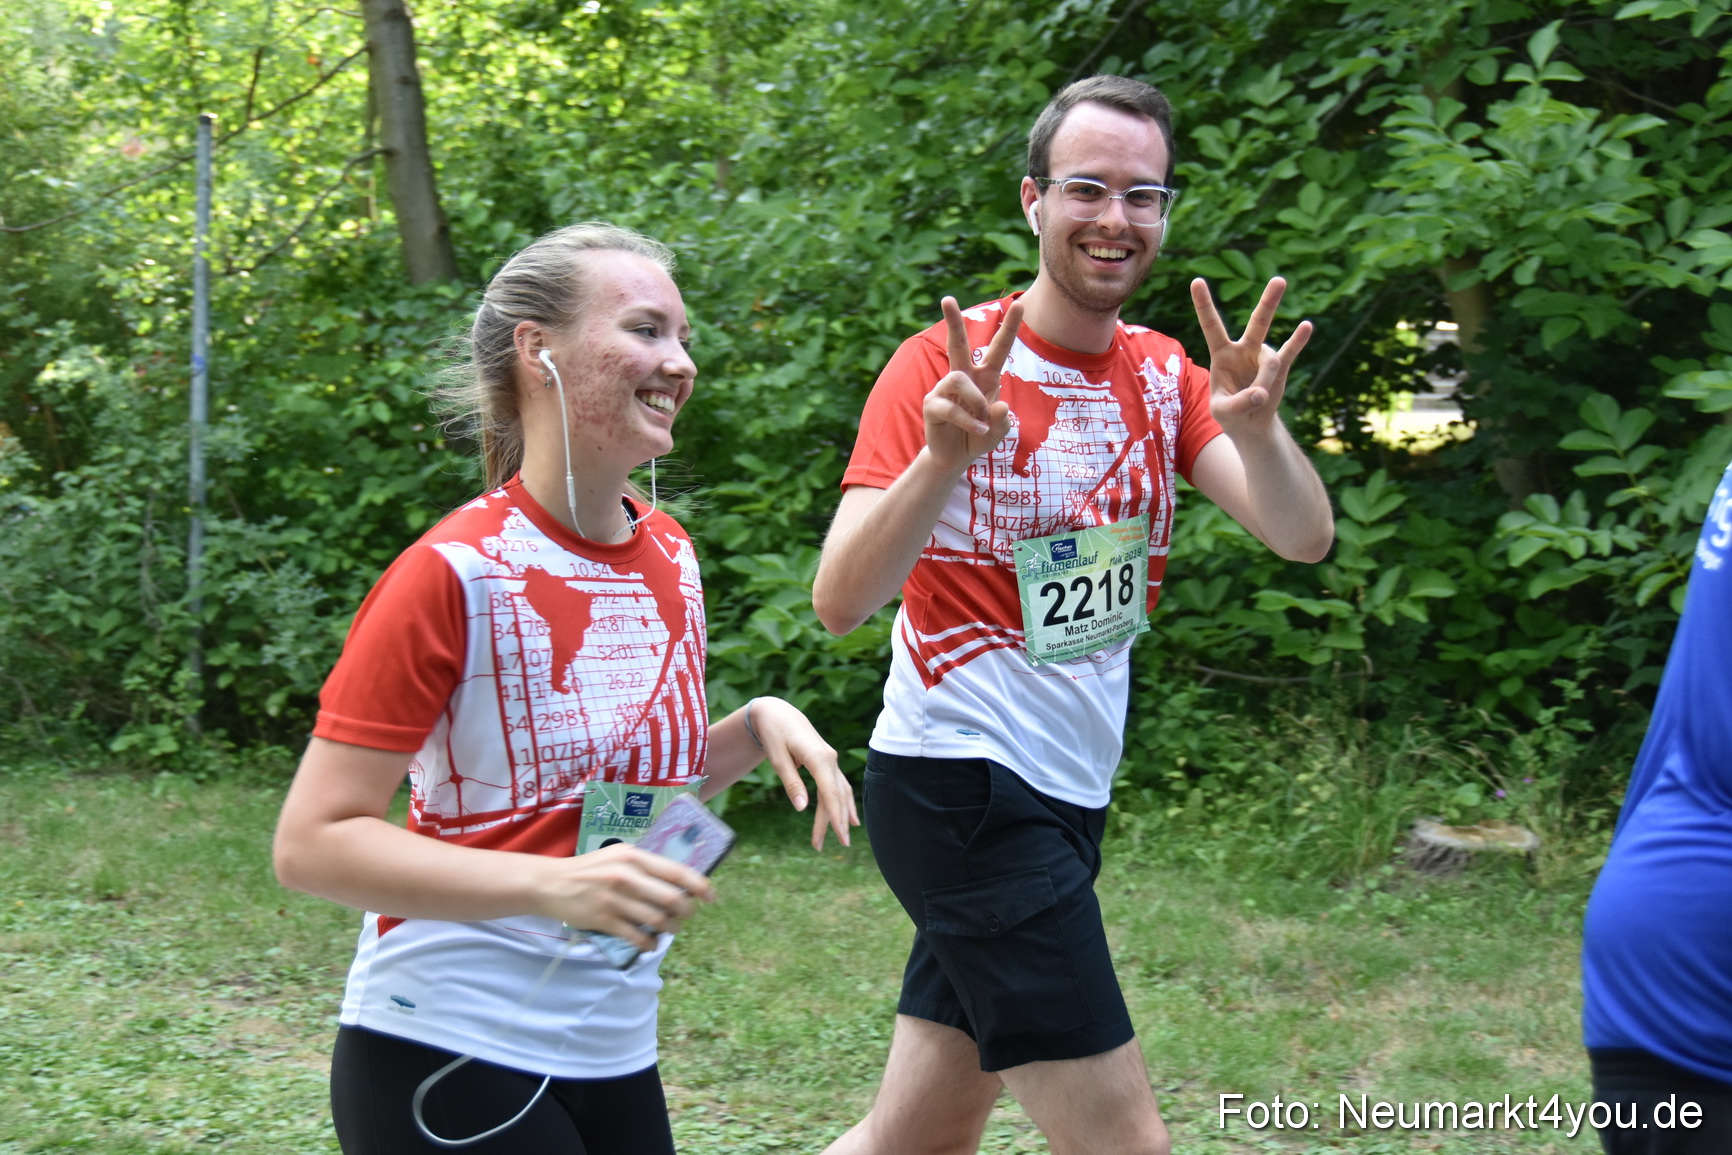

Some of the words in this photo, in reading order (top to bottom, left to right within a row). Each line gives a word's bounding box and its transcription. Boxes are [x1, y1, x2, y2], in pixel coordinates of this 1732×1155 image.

[1043, 371, 1083, 385] 10.54
[1064, 464, 1097, 479] 26.22
[569, 562, 610, 578] 10.54
[1041, 551, 1099, 574] firmenlauf
[1039, 563, 1134, 627] 2218
[1045, 636, 1084, 651] Sparkasse
[1085, 618, 1134, 642] Neumarkt-Parsberg
[1064, 623, 1089, 637] Matz
[1091, 611, 1123, 630] Dominic
[605, 671, 646, 690] 26.22
